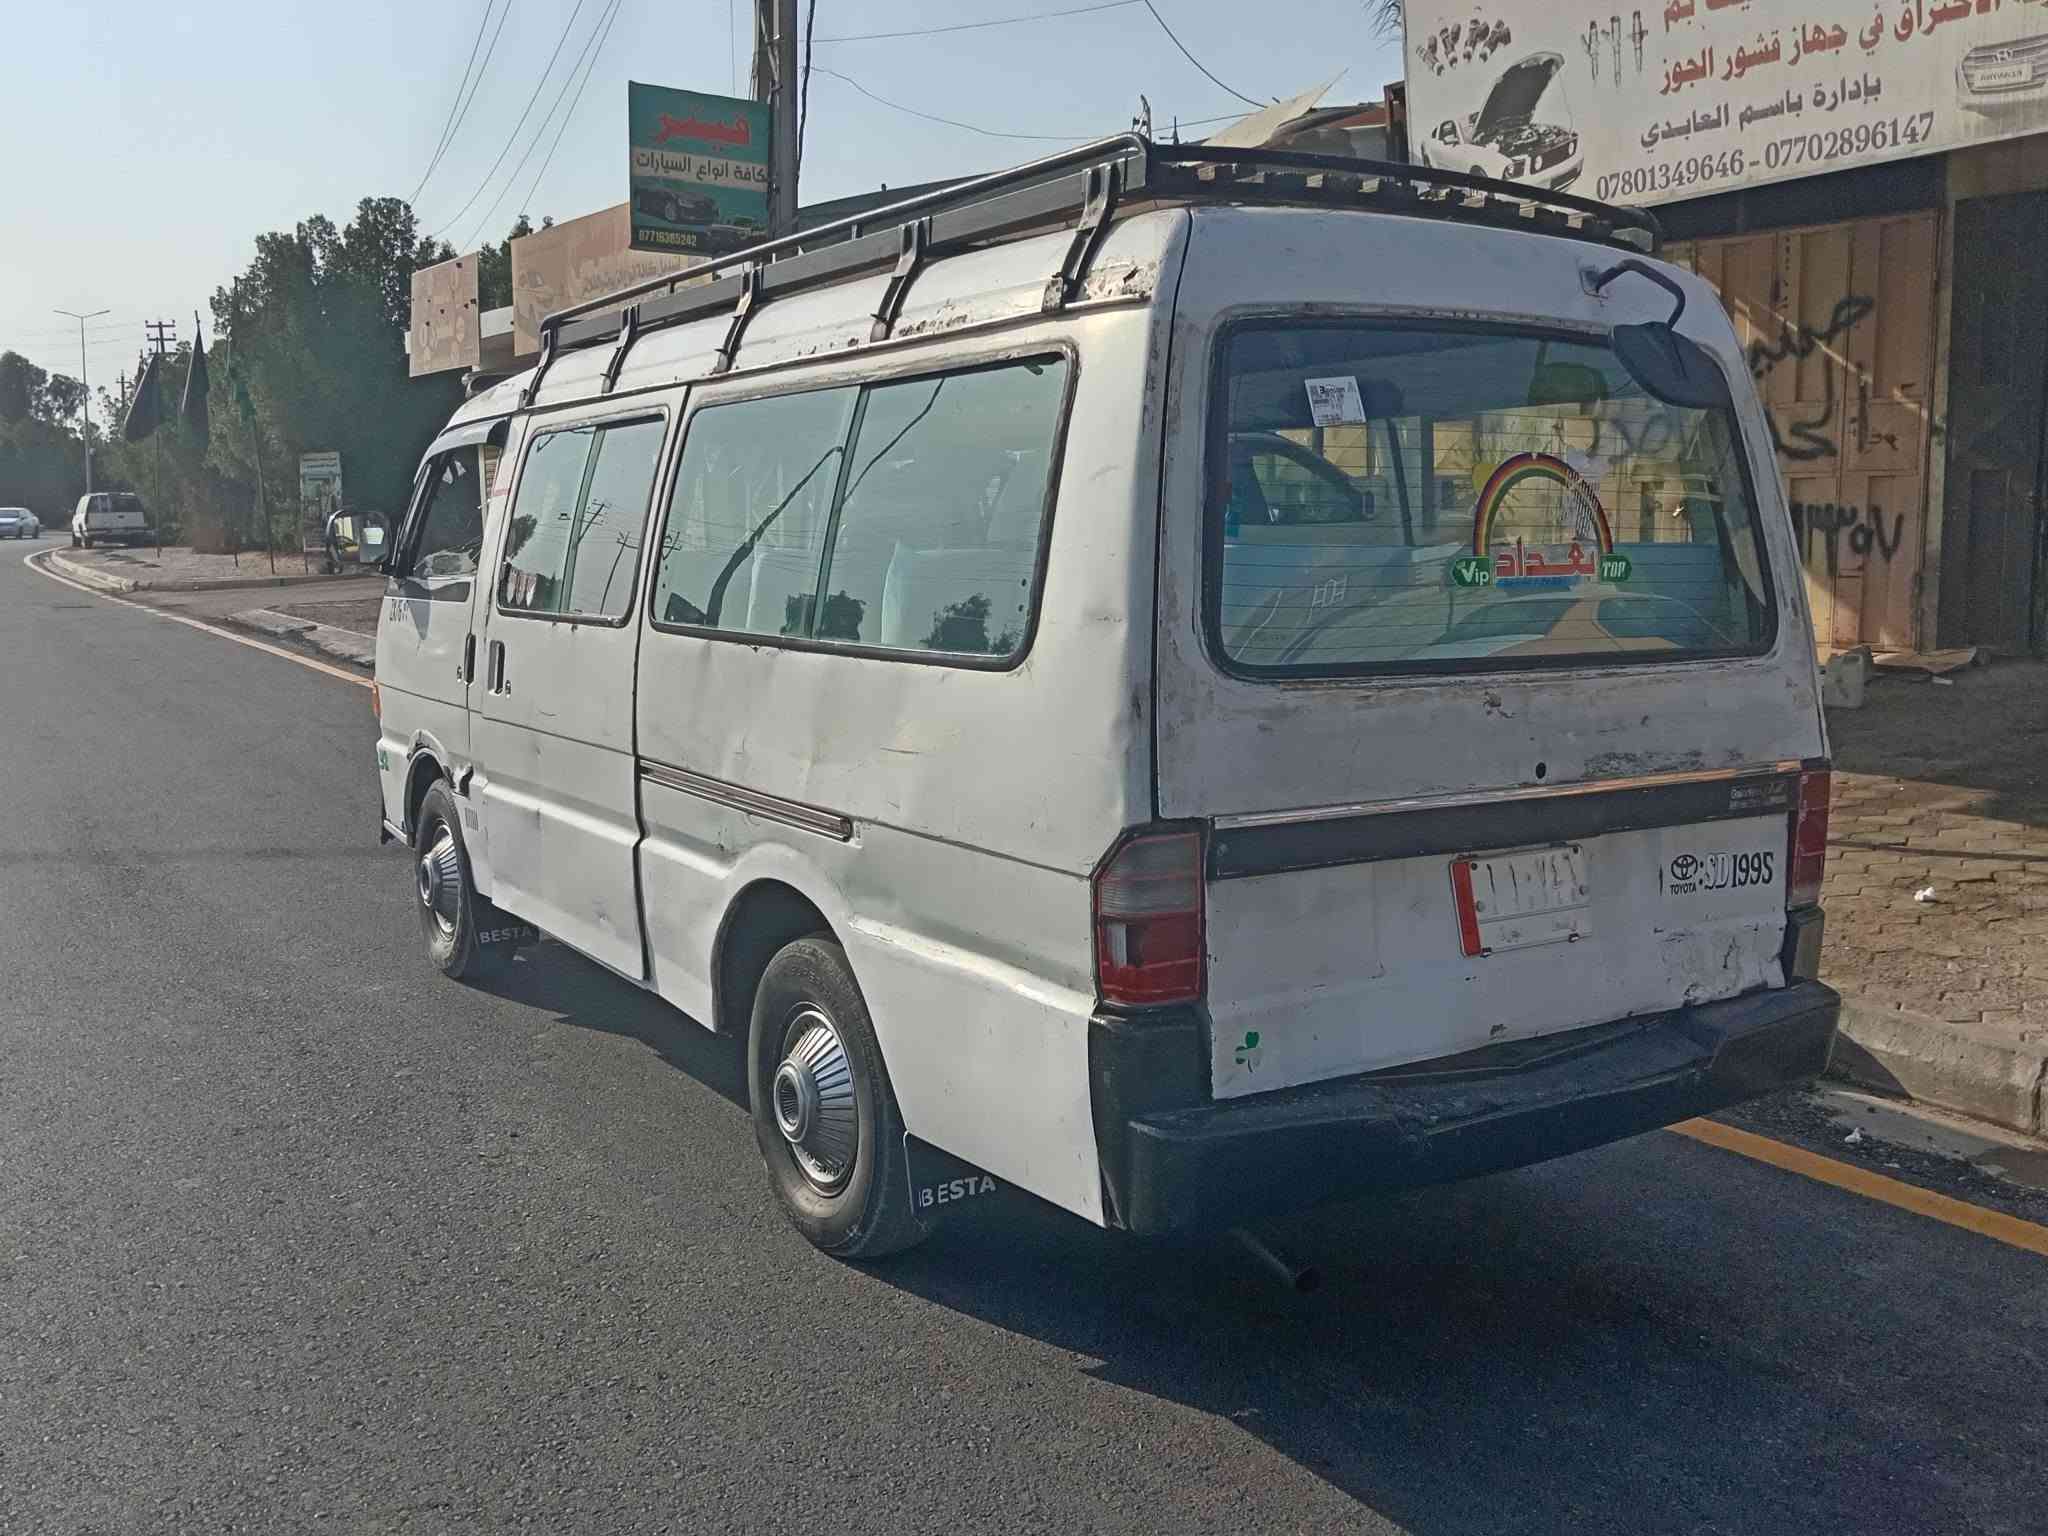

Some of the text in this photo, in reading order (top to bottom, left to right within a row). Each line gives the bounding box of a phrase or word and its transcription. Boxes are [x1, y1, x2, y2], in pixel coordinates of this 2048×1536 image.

[1787, 21, 1848, 66] جهاز
[1858, 4, 1884, 57] في
[1659, 45, 1714, 96] الجوز
[1721, 30, 1780, 81] قشور
[1640, 73, 1881, 154] بإدارة باسم العابدي
[636, 152, 768, 183] كافة انواع السيارات
[1597, 149, 1744, 201] 07801349646
[1765, 111, 1935, 169] 07702896147
[1602, 560, 1626, 578] TOP
[1669, 882, 1698, 896] TOYOTA
[479, 927, 533, 944] BESTA
[919, 1175, 997, 1208] BESTA
